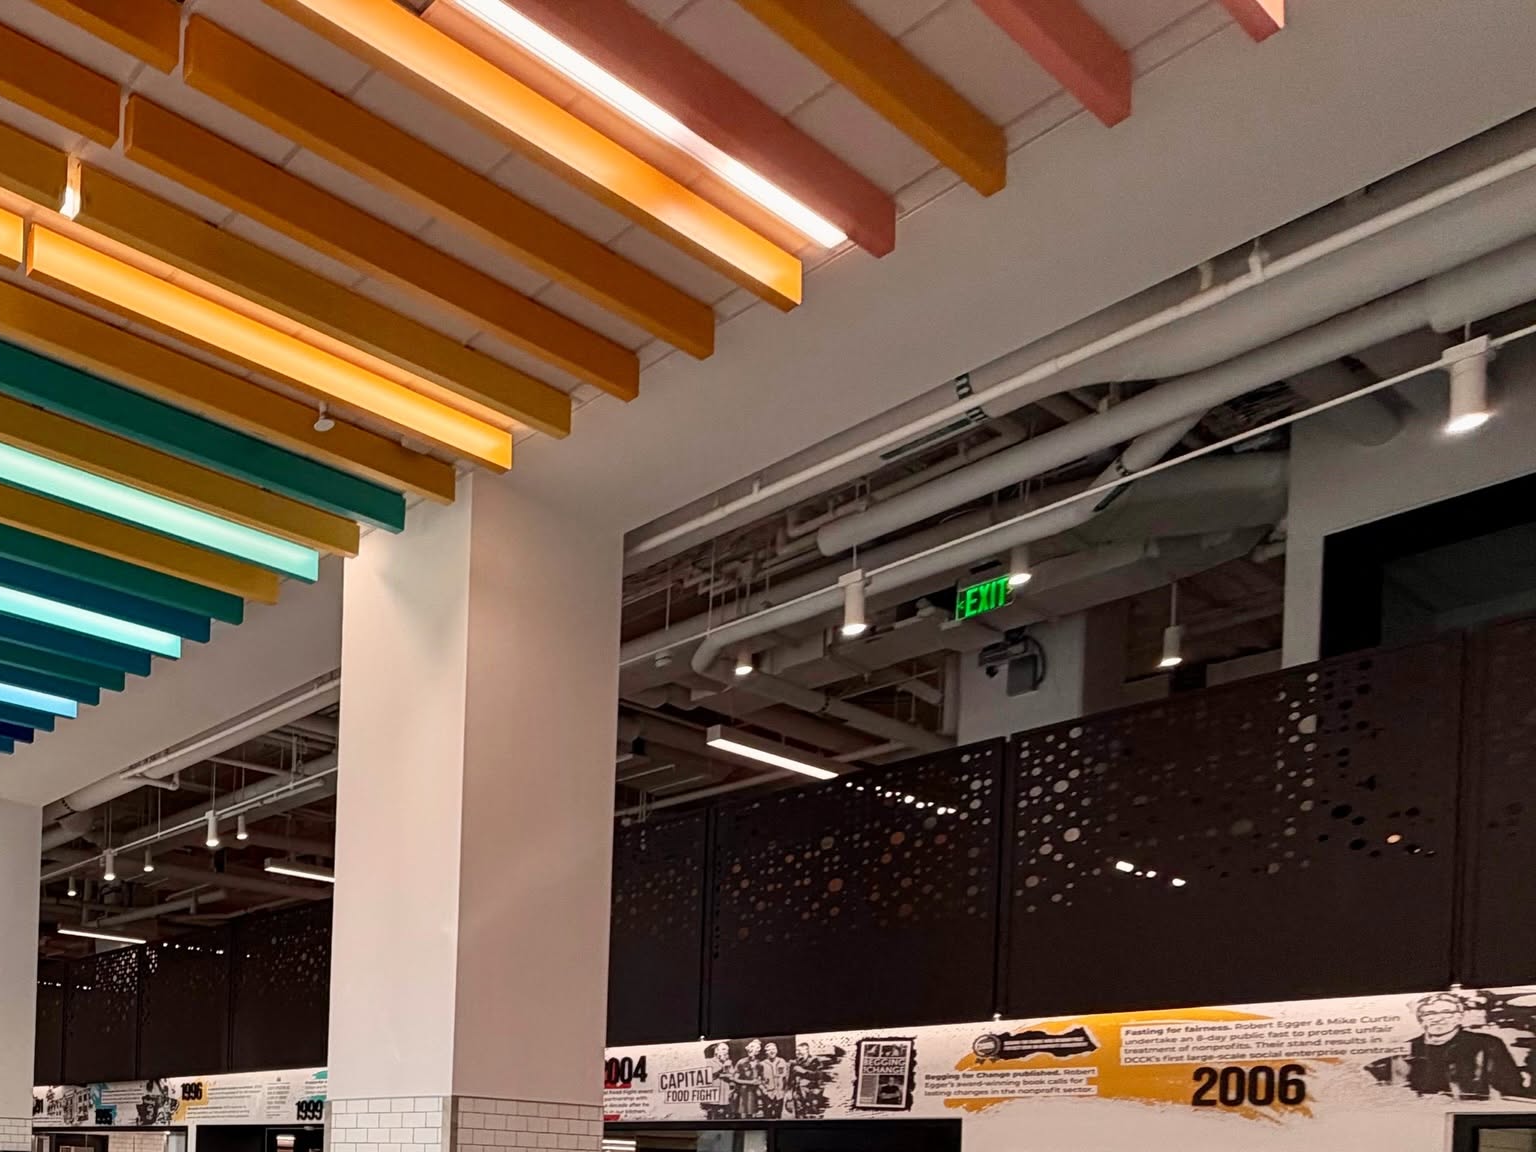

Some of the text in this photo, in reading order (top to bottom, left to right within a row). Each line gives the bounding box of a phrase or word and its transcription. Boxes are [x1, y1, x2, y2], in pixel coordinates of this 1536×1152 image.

[966, 577, 1008, 617] EXIT
[1124, 1037, 1177, 1046] undertake
[1229, 1032, 1265, 1041] public
[1307, 1027, 1353, 1037] protest
[1355, 1025, 1393, 1034] unfair
[1125, 1028, 1164, 1036] Fasting
[1184, 1025, 1232, 1033] fairness.
[1235, 1022, 1273, 1030] Robert
[1277, 1020, 1312, 1029] Egger
[1315, 1018, 1324, 1026] &
[1327, 1017, 1357, 1025] Mike
[1360, 1015, 1401, 1024] Curtin
[1124, 1046, 1177, 1054] treatment
[1178, 1044, 1190, 1052] of
[1191, 1042, 1252, 1052] nonprofits.
[1255, 1040, 1285, 1048] Their
[1287, 1038, 1321, 1047] stand
[1325, 1037, 1367, 1045] results
[1187, 1052, 1246, 1062] large-scale
[1249, 1050, 1282, 1058] social
[1285, 1047, 1347, 1057] enterprise
[604, 1055, 648, 1084] 004
[660, 1069, 713, 1090] CAPITAL
[925, 1072, 960, 1080] Begging
[181, 1082, 203, 1101] 1996
[666, 1088, 718, 1102] FOOD FIGHT
[1192, 1064, 1306, 1106] 2006
[295, 1100, 324, 1121] 1999
